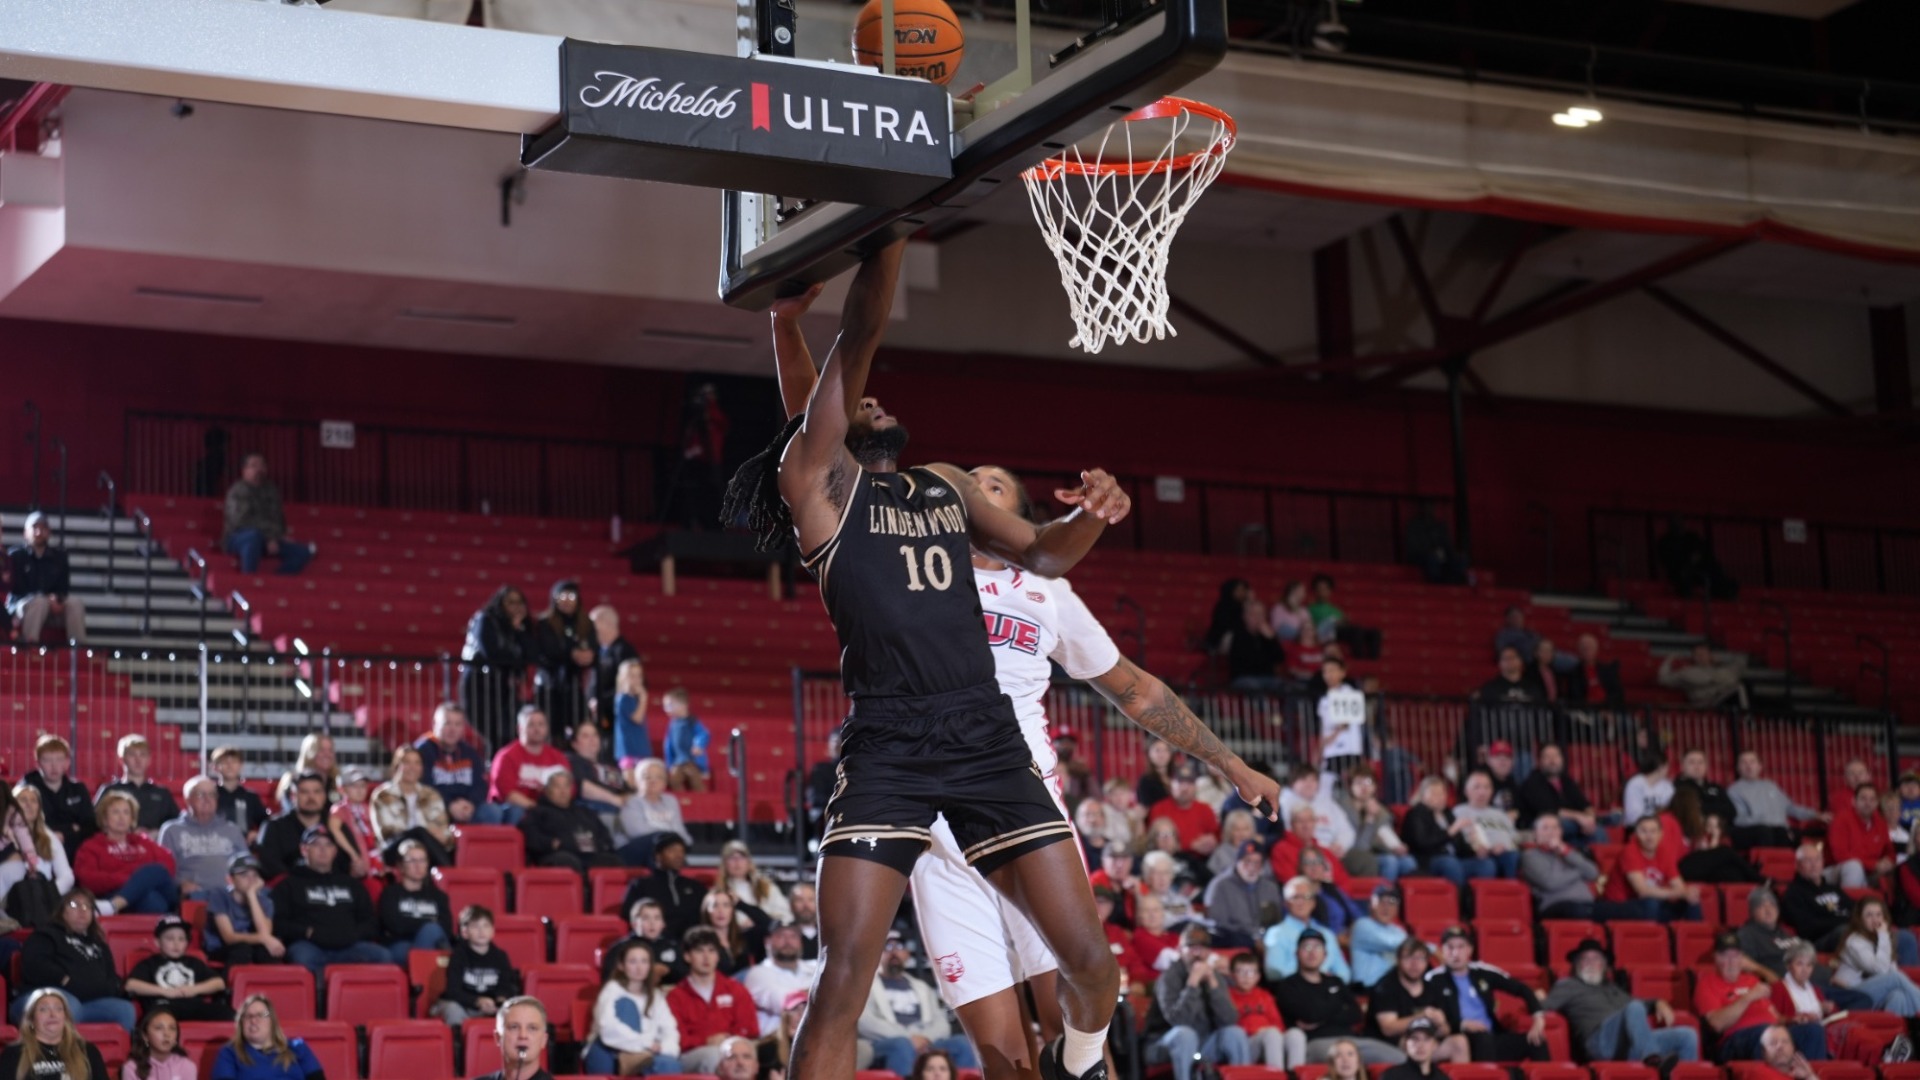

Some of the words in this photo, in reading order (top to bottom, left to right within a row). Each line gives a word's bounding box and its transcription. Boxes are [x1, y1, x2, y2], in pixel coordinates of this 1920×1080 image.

[894, 28, 937, 45] NCA
[579, 71, 743, 120] Michelob
[869, 504, 966, 538] LINDENWOOD
[899, 545, 953, 592] 10
[982, 609, 1041, 656] UE
[1332, 698, 1361, 718] 110
